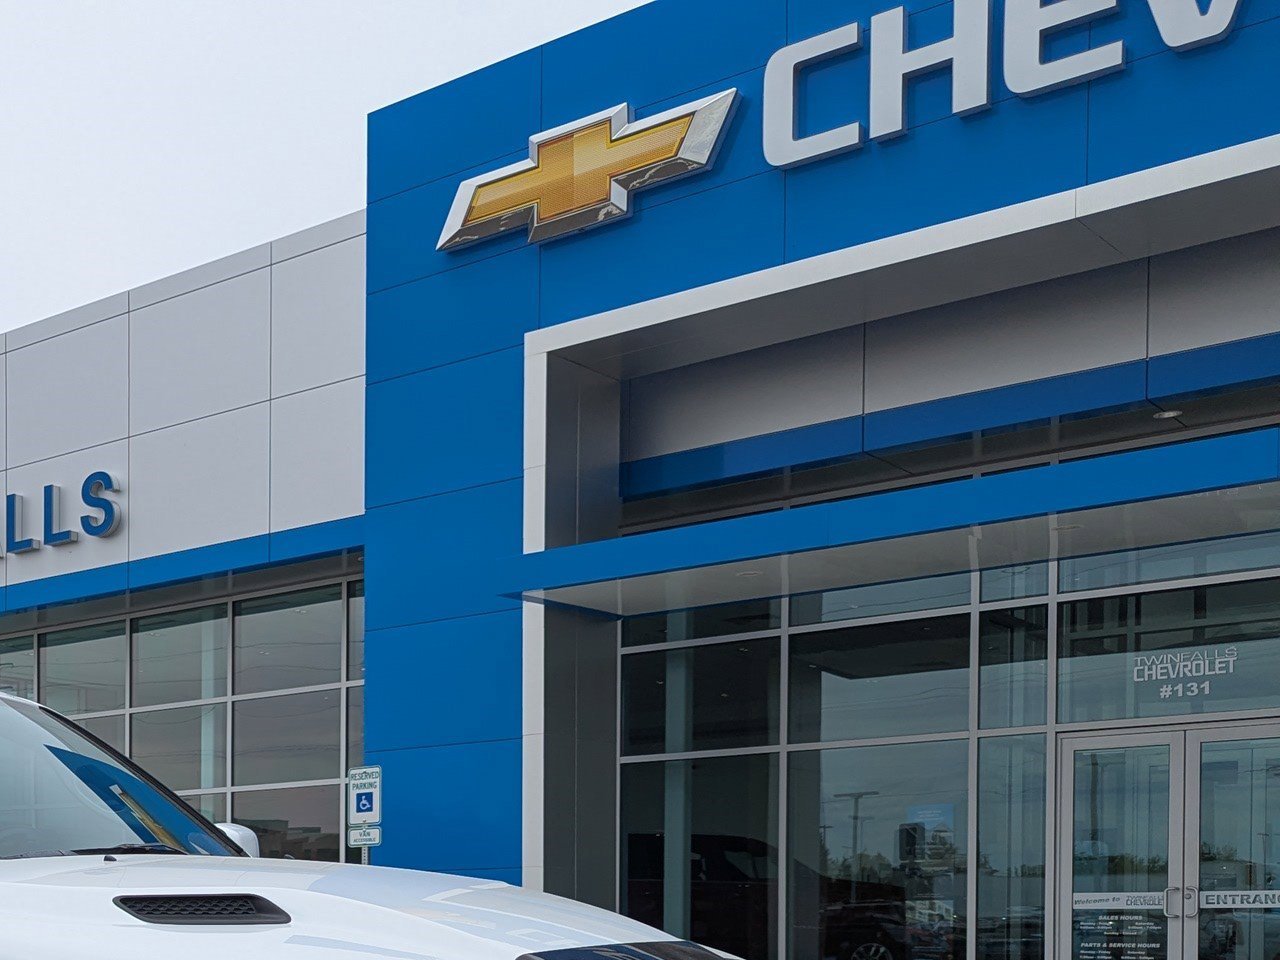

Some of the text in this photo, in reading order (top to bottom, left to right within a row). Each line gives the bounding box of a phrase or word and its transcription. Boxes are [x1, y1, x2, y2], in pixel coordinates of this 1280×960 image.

[1133, 657, 1238, 682] CHEVROLET
[1159, 681, 1210, 699] #131
[350, 771, 380, 781] RESERVED
[352, 781, 378, 791] PARKING
[1075, 897, 1109, 906] Welcome
